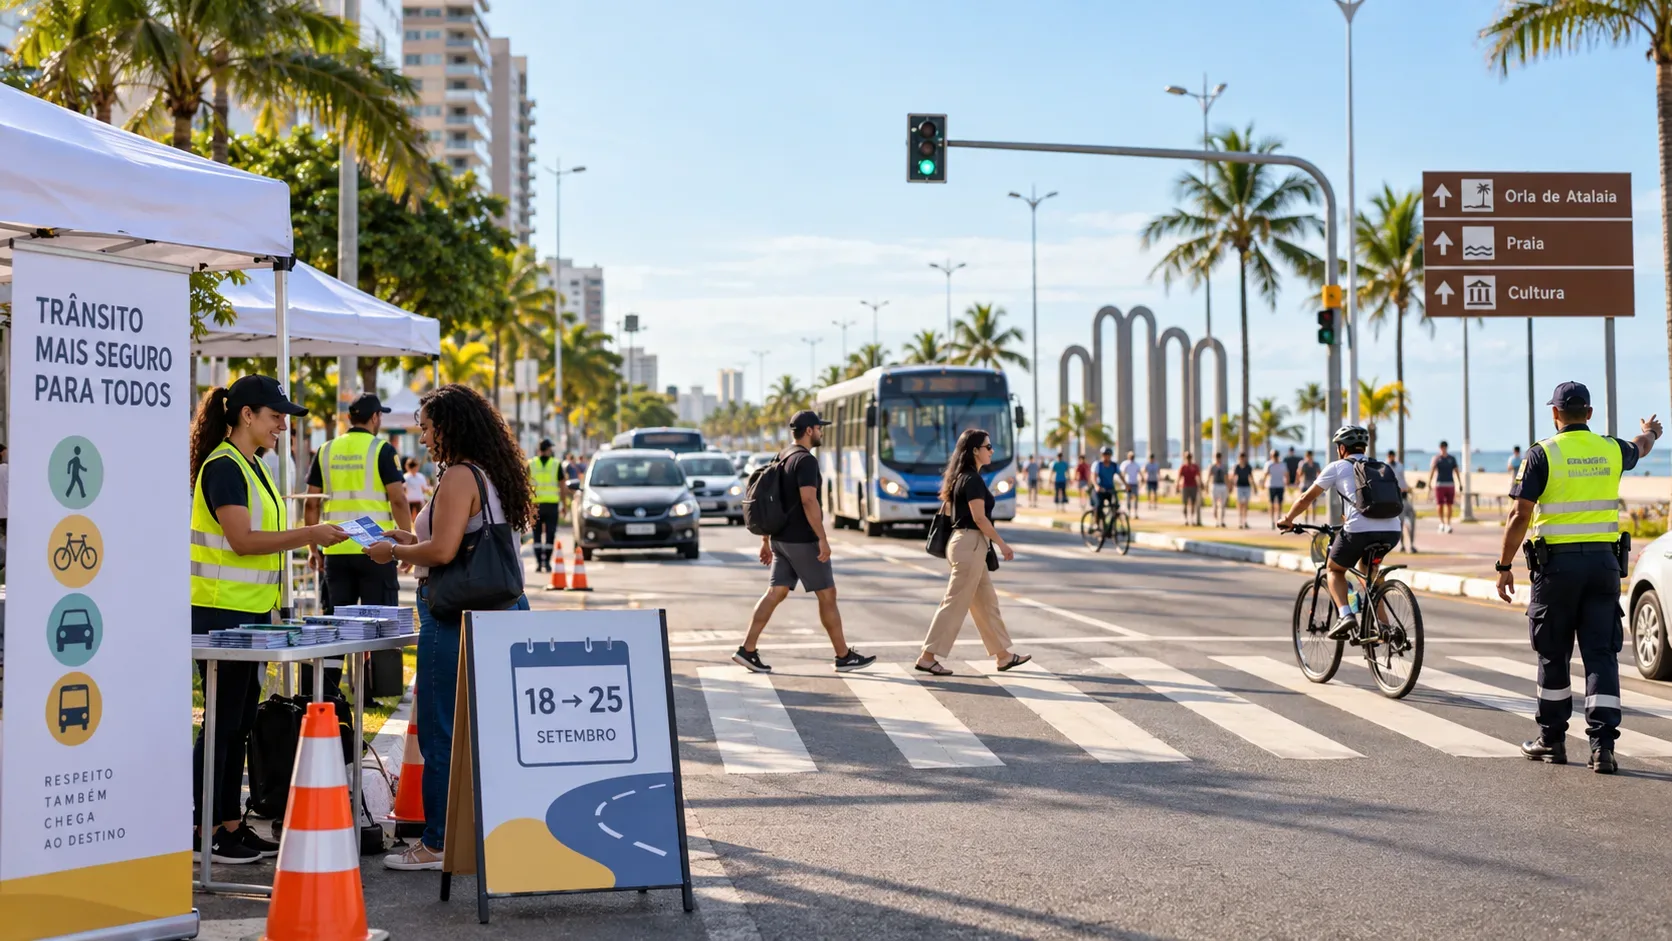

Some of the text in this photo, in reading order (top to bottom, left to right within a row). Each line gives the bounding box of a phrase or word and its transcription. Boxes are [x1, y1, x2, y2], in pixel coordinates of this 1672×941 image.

[1505, 189, 1617, 203] Orla de Atalaia
[1507, 236, 1544, 250] Praia
[1508, 285, 1565, 300] Cultura
[36, 293, 143, 333] TRÂNSITO
[36, 335, 172, 372] MAIS SEGURO
[35, 374, 171, 408] PARA TODOS
[525, 685, 623, 715] 18 25
[537, 728, 616, 744] SETEMBRO
[44, 768, 113, 787] RESPEITO
[44, 788, 107, 808] TAMBÉM
[44, 811, 95, 829] CHEGA
[44, 827, 126, 850] AO DESTINO
